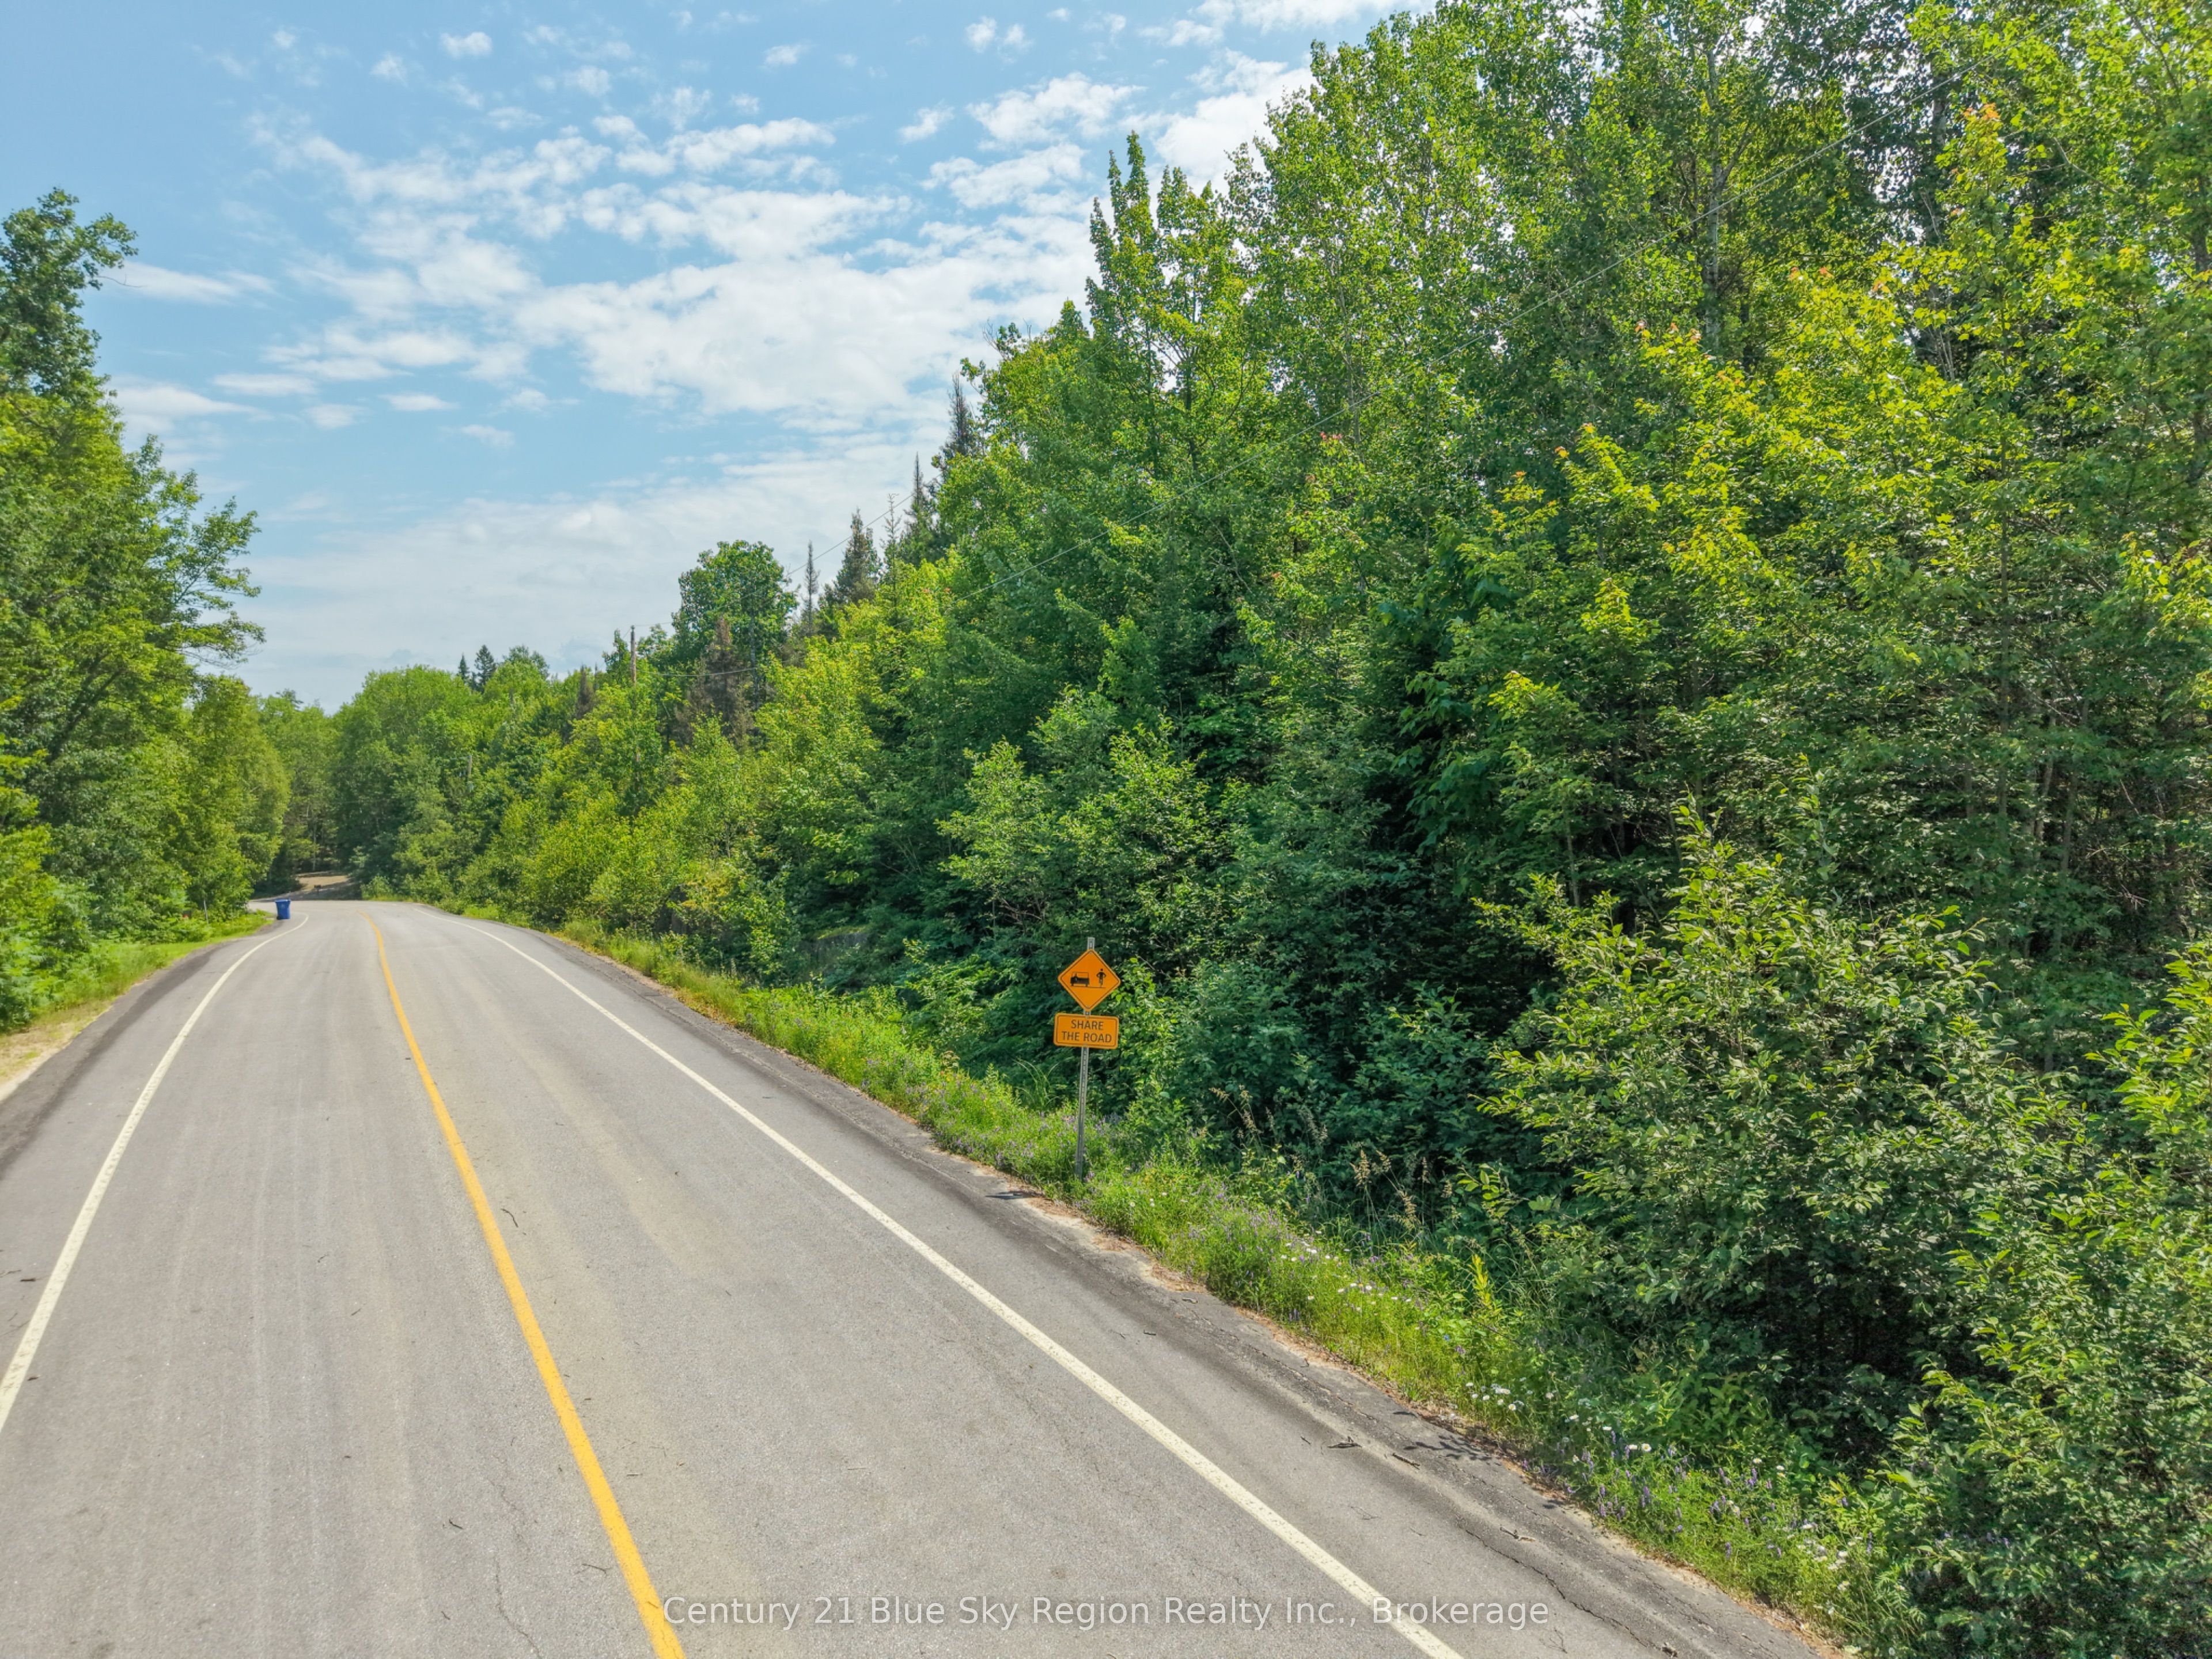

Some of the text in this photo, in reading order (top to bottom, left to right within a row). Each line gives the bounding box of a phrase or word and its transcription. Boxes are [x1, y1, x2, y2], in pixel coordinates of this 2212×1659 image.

[1071, 1020, 1104, 1030] SHARE
[1062, 1031, 1112, 1043] THE ROAD
